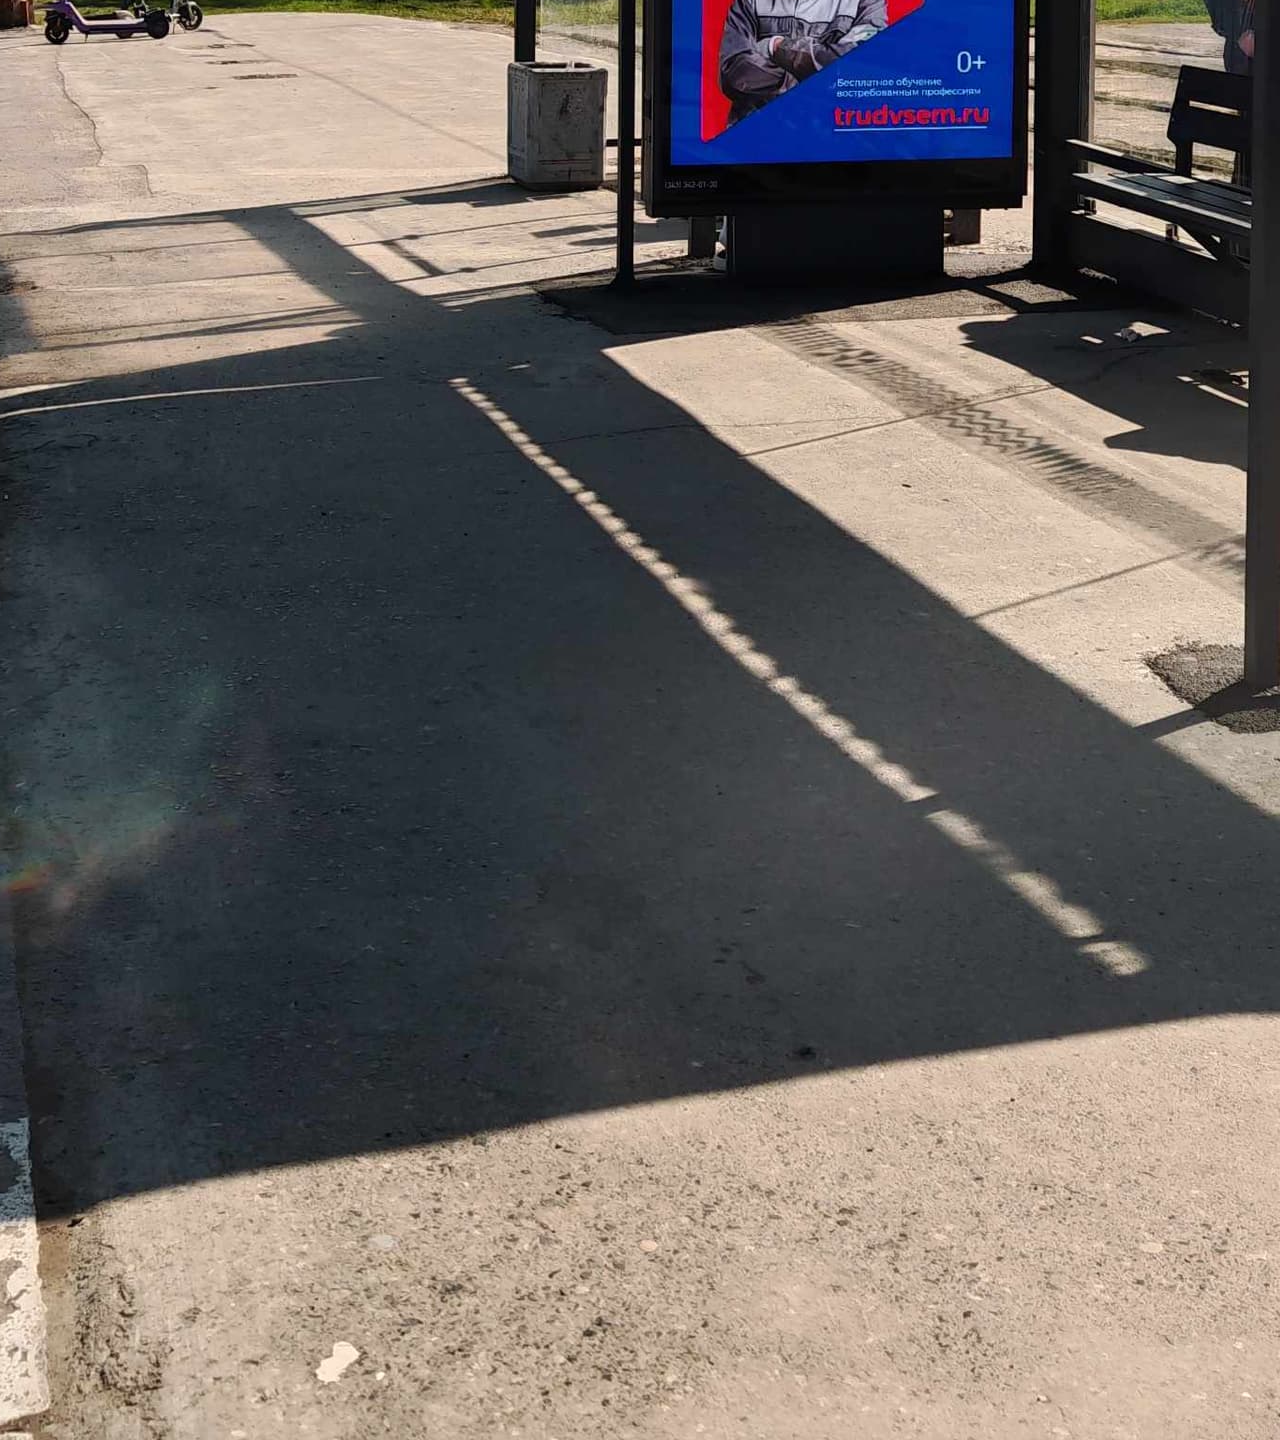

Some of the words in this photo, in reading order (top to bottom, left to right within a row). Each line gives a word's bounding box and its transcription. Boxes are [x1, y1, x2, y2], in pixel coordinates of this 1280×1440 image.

[957, 51, 987, 73] 0+
[837, 78, 895, 88] Бесплатное
[896, 77, 942, 88] обучение
[836, 88, 919, 98] востребованным
[922, 88, 981, 98] профессиям
[834, 104, 989, 126] trudvsem.ru
